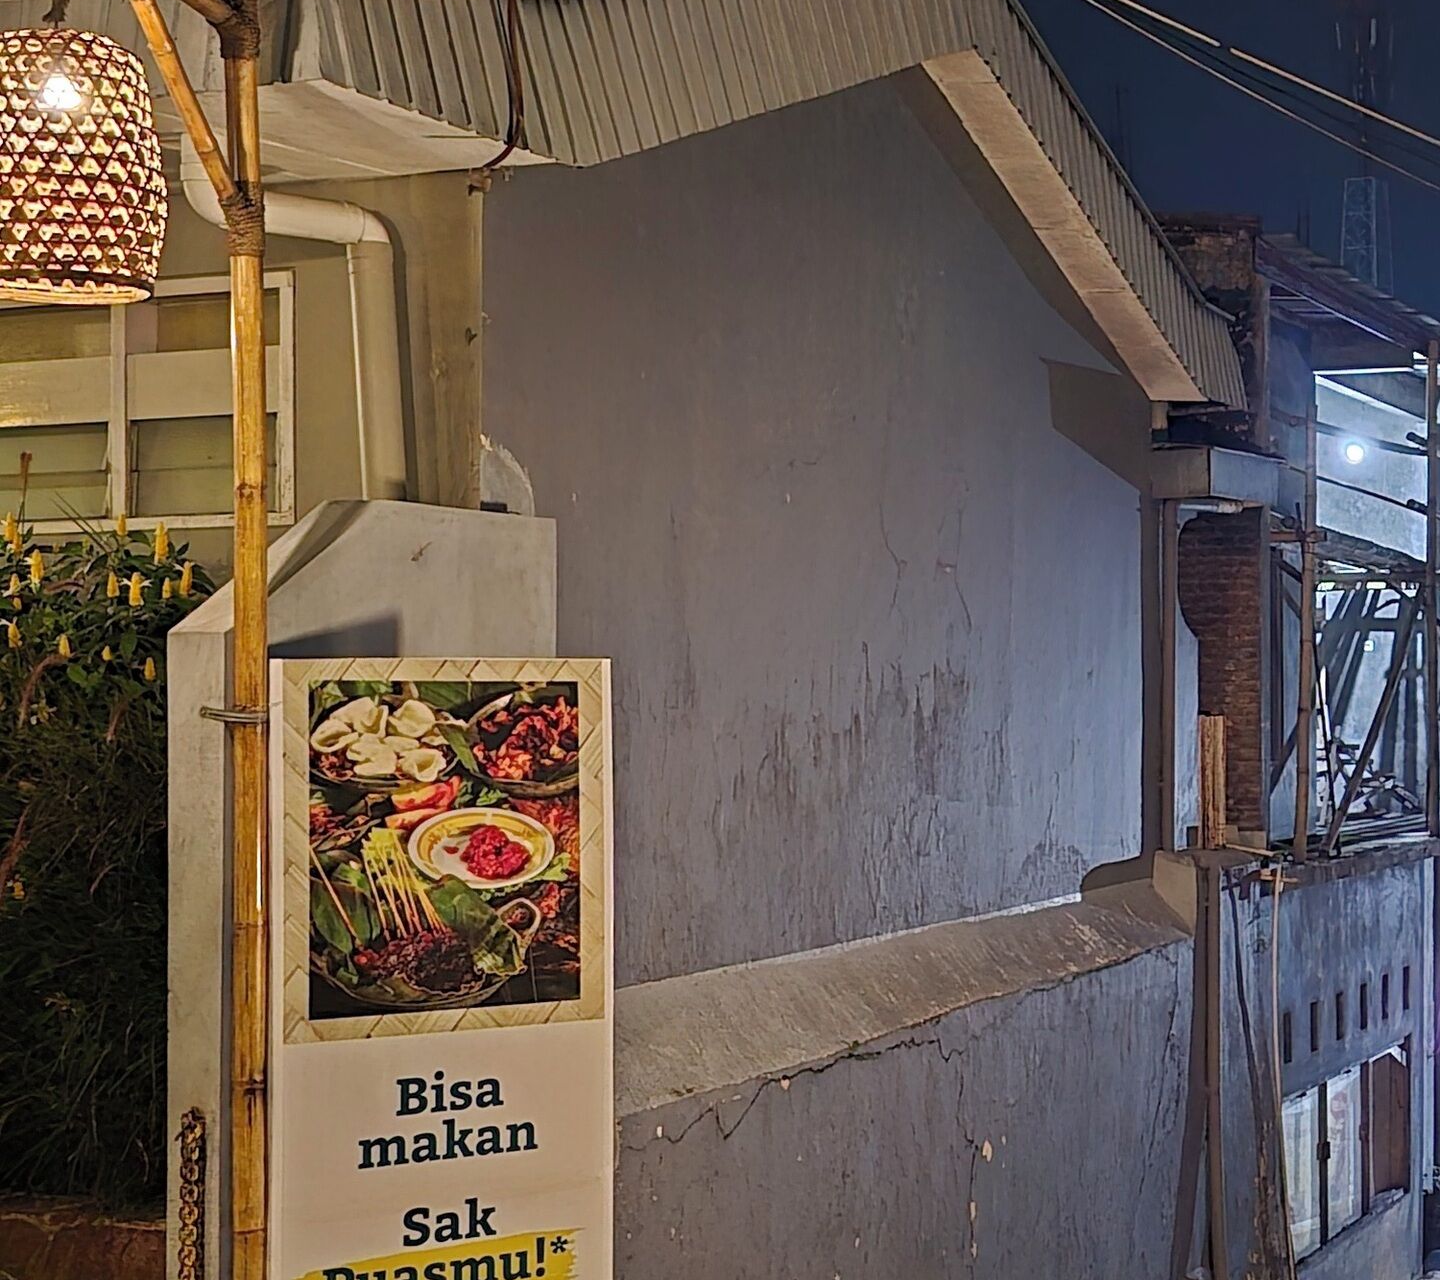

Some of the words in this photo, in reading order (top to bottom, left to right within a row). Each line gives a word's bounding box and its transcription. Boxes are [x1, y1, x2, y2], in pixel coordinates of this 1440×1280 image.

[395, 1070, 504, 1117] Bisa
[357, 1118, 538, 1169] makan
[402, 1197, 497, 1247] Sak
